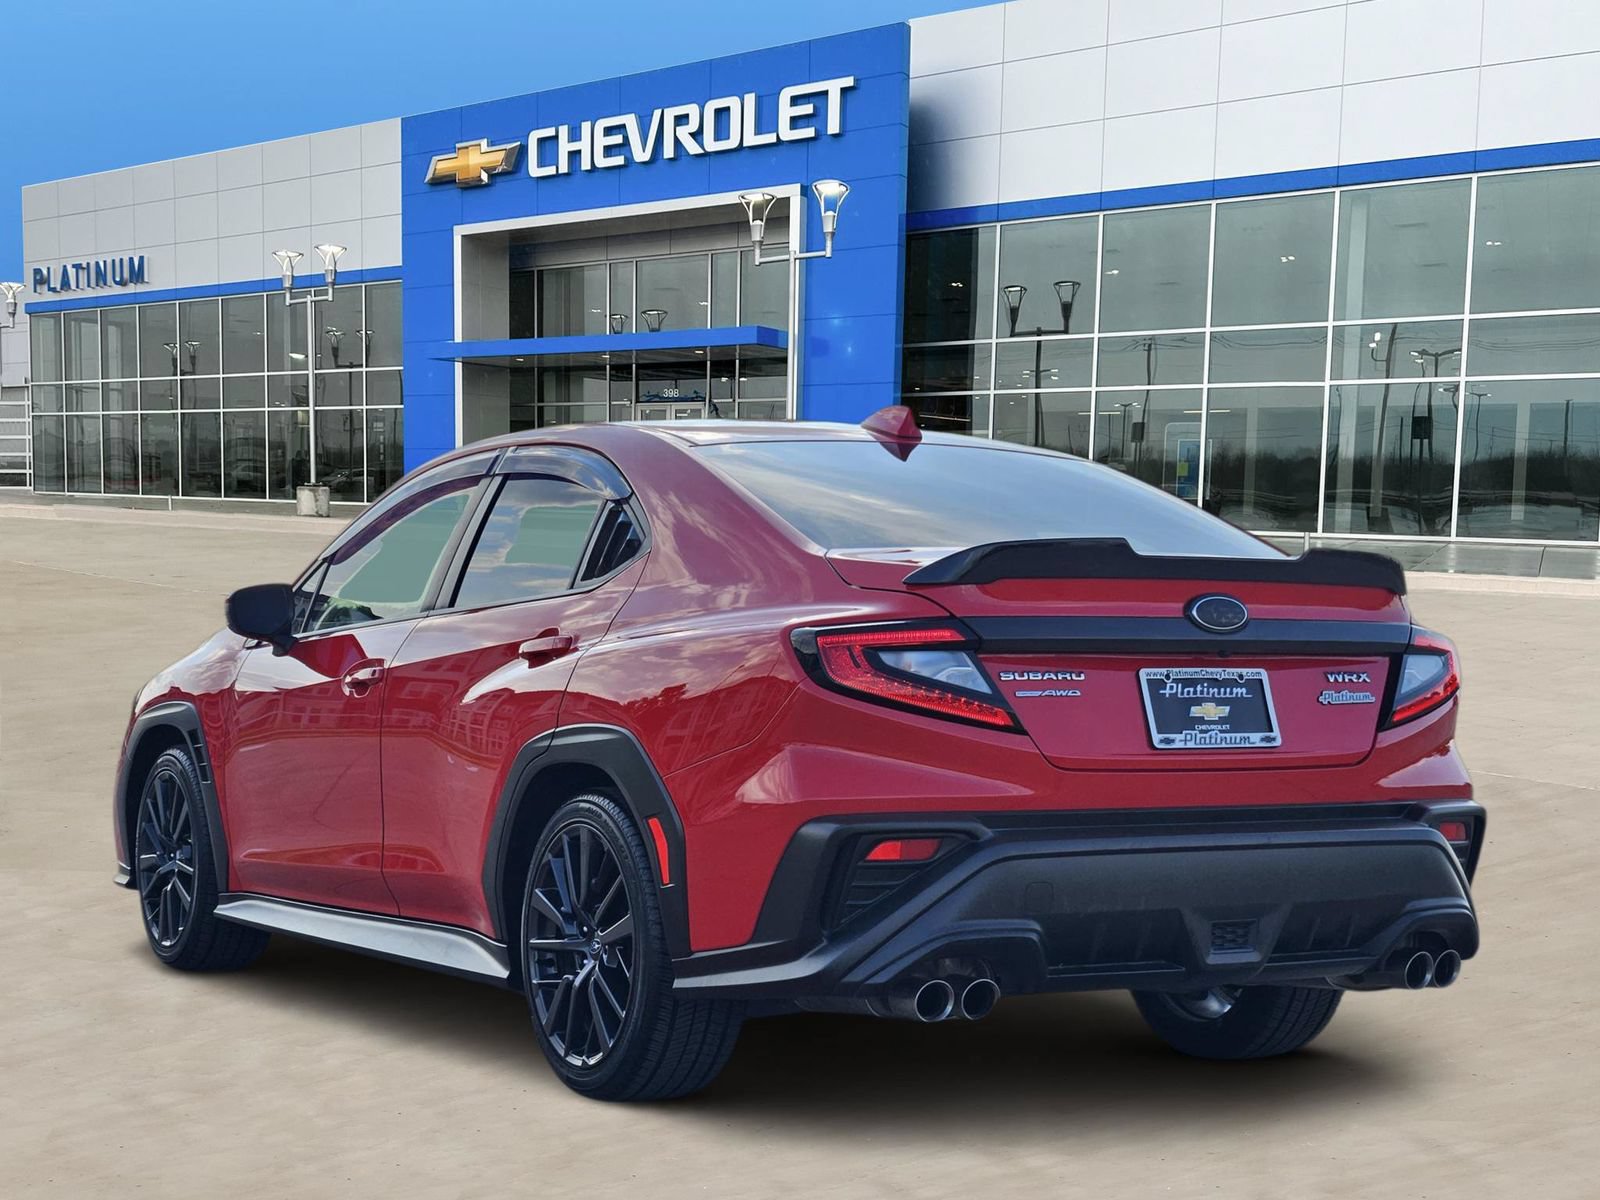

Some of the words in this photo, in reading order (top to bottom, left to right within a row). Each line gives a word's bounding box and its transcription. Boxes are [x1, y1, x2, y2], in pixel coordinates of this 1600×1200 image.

[527, 75, 855, 178] CHEVROLET
[33, 255, 146, 294] PLATINUM
[663, 388, 680, 398] 398
[1000, 672, 1085, 681] SUBARU
[1145, 669, 1262, 678] wwwPlatinumChevyTexa.com
[1327, 672, 1371, 683] WRX
[1159, 683, 1253, 698] Platinum
[1319, 690, 1376, 704] Platinum
[1179, 732, 1257, 746] Platinum
